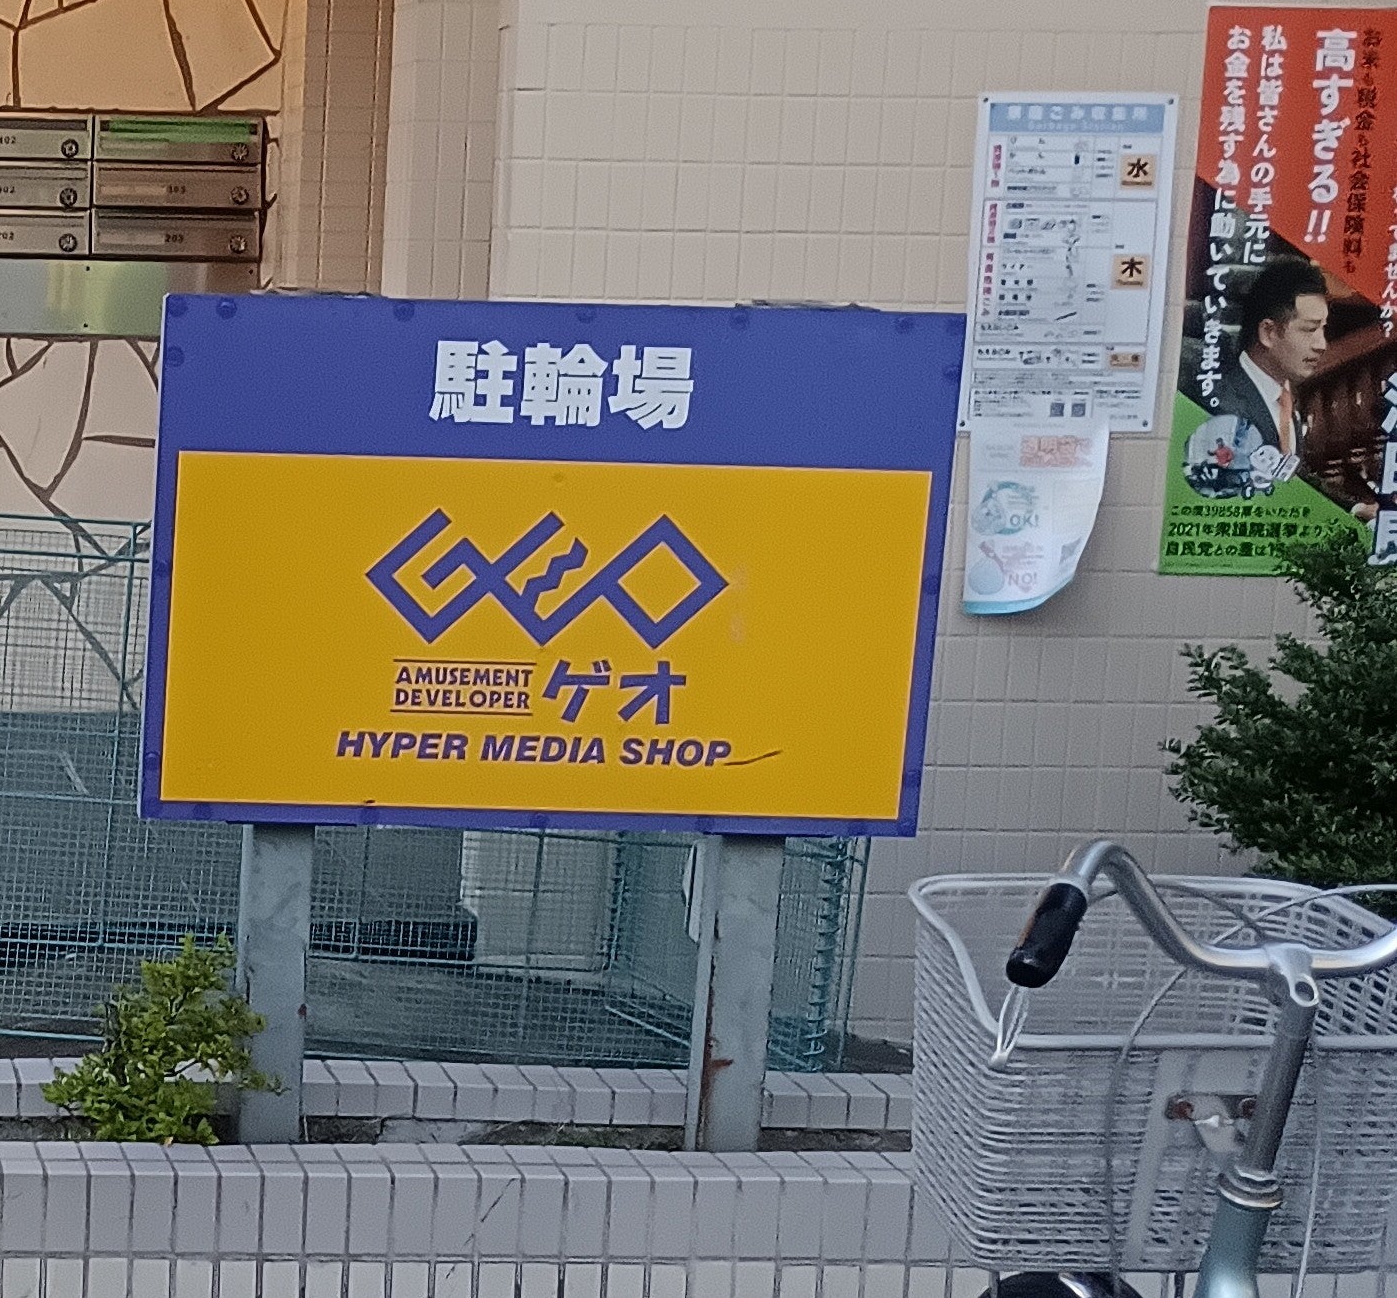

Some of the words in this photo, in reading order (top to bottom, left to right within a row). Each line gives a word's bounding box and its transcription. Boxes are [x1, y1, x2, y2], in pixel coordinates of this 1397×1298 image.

[1243, 25, 1287, 264] 私は皆さんの手元に
[1304, 28, 1357, 243] 高すぎる!!
[1126, 157, 1149, 178] 水
[1196, 25, 1251, 408] お金を残す為に動いています。
[1121, 257, 1144, 278] 木
[430, 340, 694, 429] 駐輪場
[1009, 514, 1039, 528] OK!
[365, 507, 729, 649] GEO
[1008, 572, 1038, 586] NO!
[394, 665, 534, 689] AMUSEMENT
[541, 658, 687, 726] ゲオ
[394, 688, 532, 711] DEVELOPER
[335, 730, 469, 761] HYPER
[479, 734, 606, 765] MEDIA
[619, 738, 732, 768] SHOP
